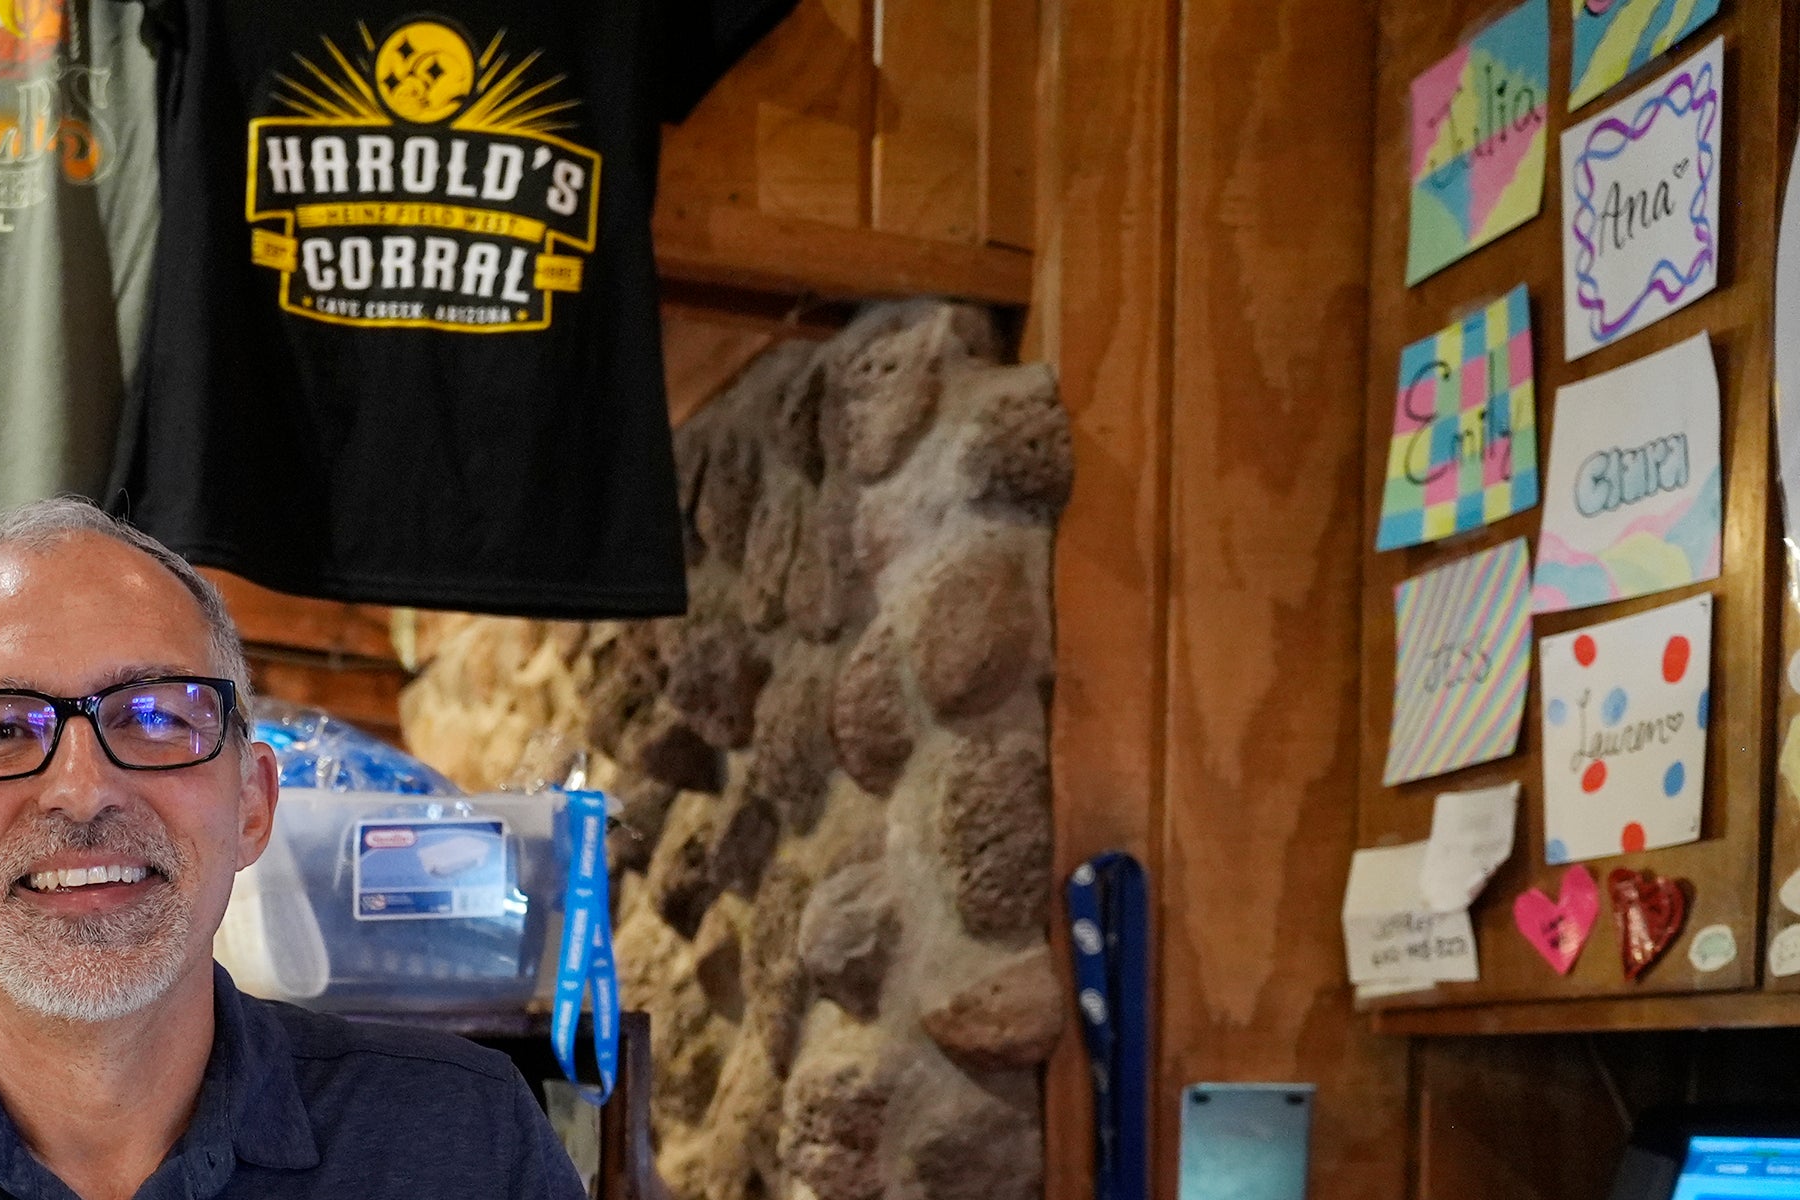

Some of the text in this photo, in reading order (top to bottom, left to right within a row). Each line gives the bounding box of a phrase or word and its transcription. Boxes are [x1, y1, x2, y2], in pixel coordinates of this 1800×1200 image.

[264, 134, 586, 217] HAROLD'S
[326, 205, 387, 222] HEINZ
[396, 205, 456, 225] FIELD
[1598, 179, 1675, 255] Ana
[301, 235, 530, 304] CORRAL
[315, 295, 361, 317] CAVE
[434, 304, 512, 325] ARIZONA
